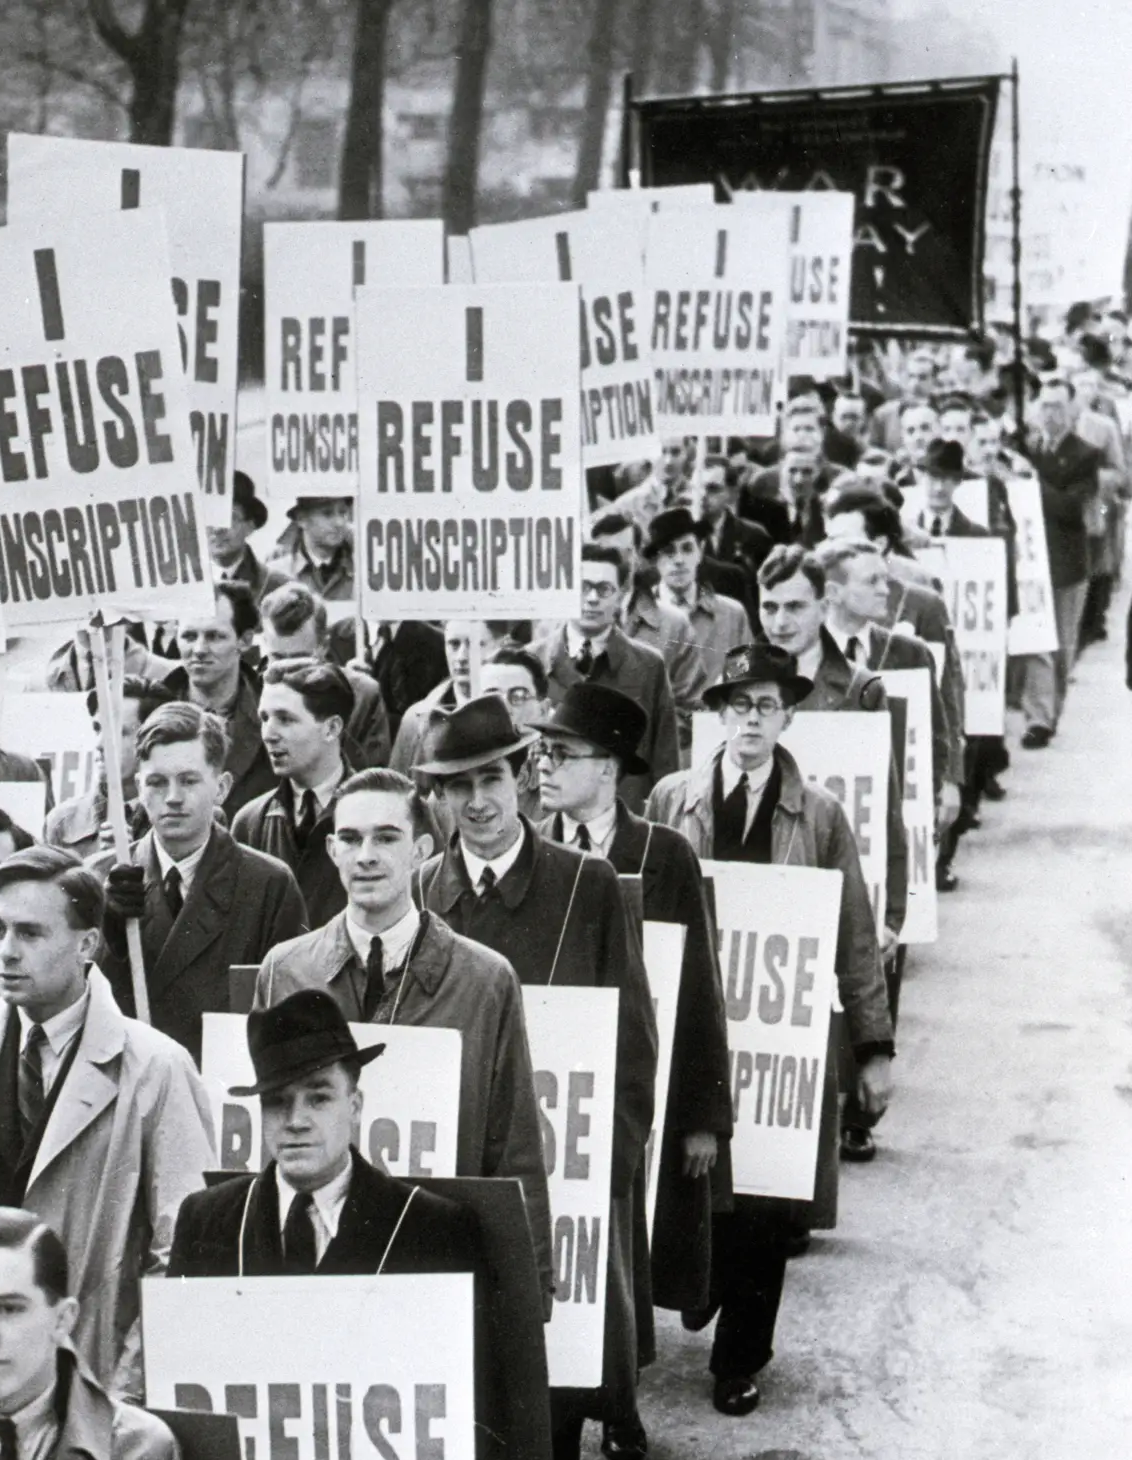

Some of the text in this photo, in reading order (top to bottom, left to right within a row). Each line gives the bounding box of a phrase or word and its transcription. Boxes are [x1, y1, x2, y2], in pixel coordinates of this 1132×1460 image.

[555, 231, 572, 281] I
[715, 229, 727, 278] I
[33, 247, 65, 341] I
[651, 289, 773, 351] REFUSE
[281, 316, 350, 392] REF
[466, 306, 484, 382] I
[376, 397, 563, 494] REFUSE
[367, 516, 575, 593] CONSCRIPTION
[718, 928, 820, 1028] USE
